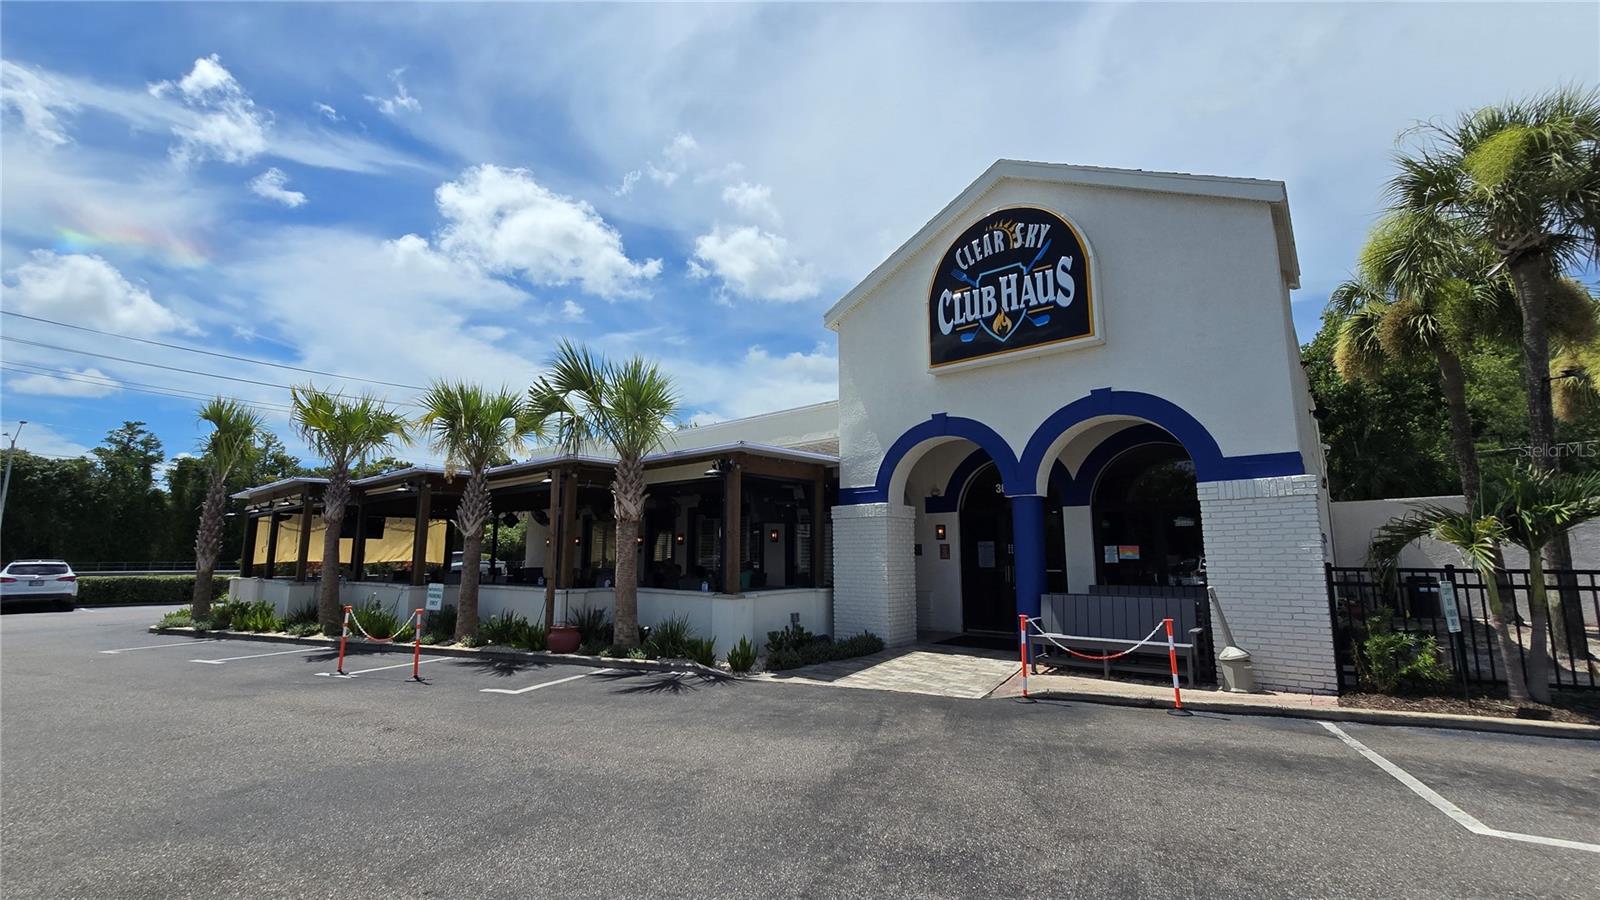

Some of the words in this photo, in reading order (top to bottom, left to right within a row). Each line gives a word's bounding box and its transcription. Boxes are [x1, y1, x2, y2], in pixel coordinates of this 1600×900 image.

[955, 230, 1005, 270] CLEAR
[1014, 222, 1051, 249] SKY
[937, 284, 998, 336] CLUB
[999, 255, 1076, 313] HAUS
